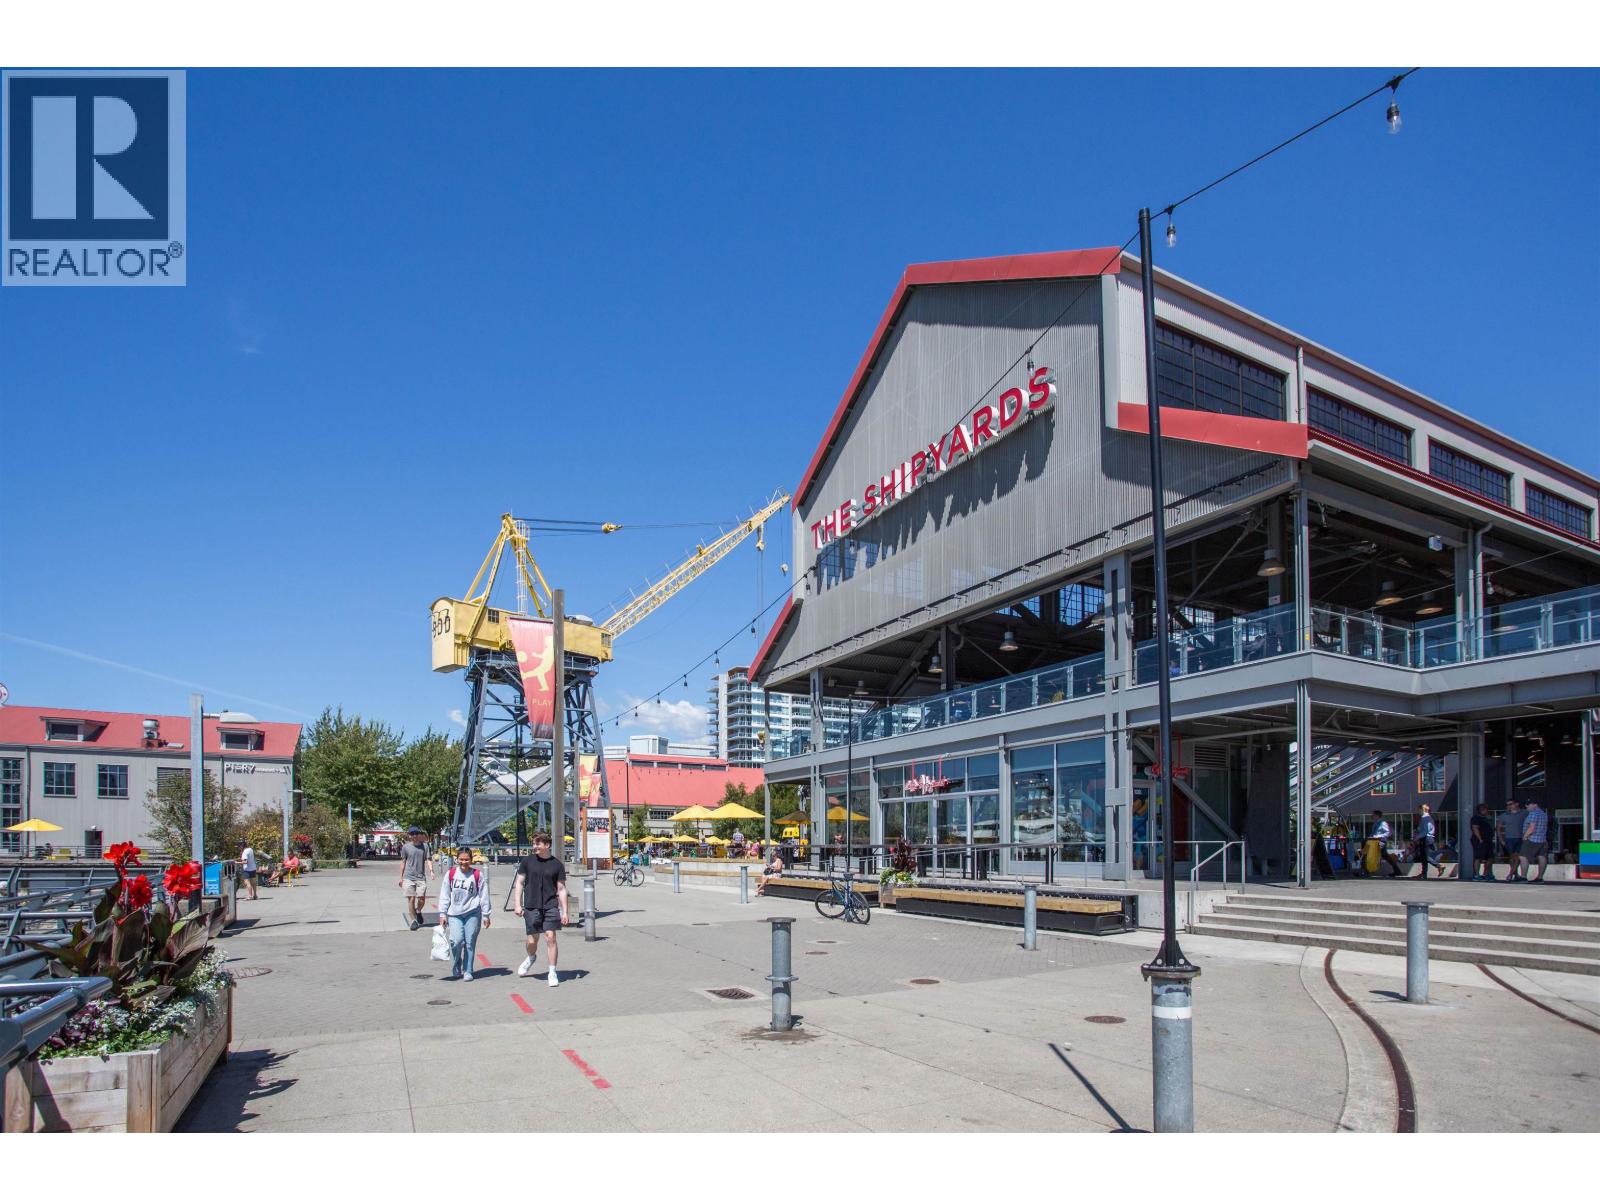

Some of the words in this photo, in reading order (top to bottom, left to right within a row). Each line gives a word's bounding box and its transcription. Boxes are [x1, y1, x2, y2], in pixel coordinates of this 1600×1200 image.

[811, 498, 857, 549] THE
[864, 366, 1056, 516] SHIPYARDS
[532, 698, 553, 707] PLAY
